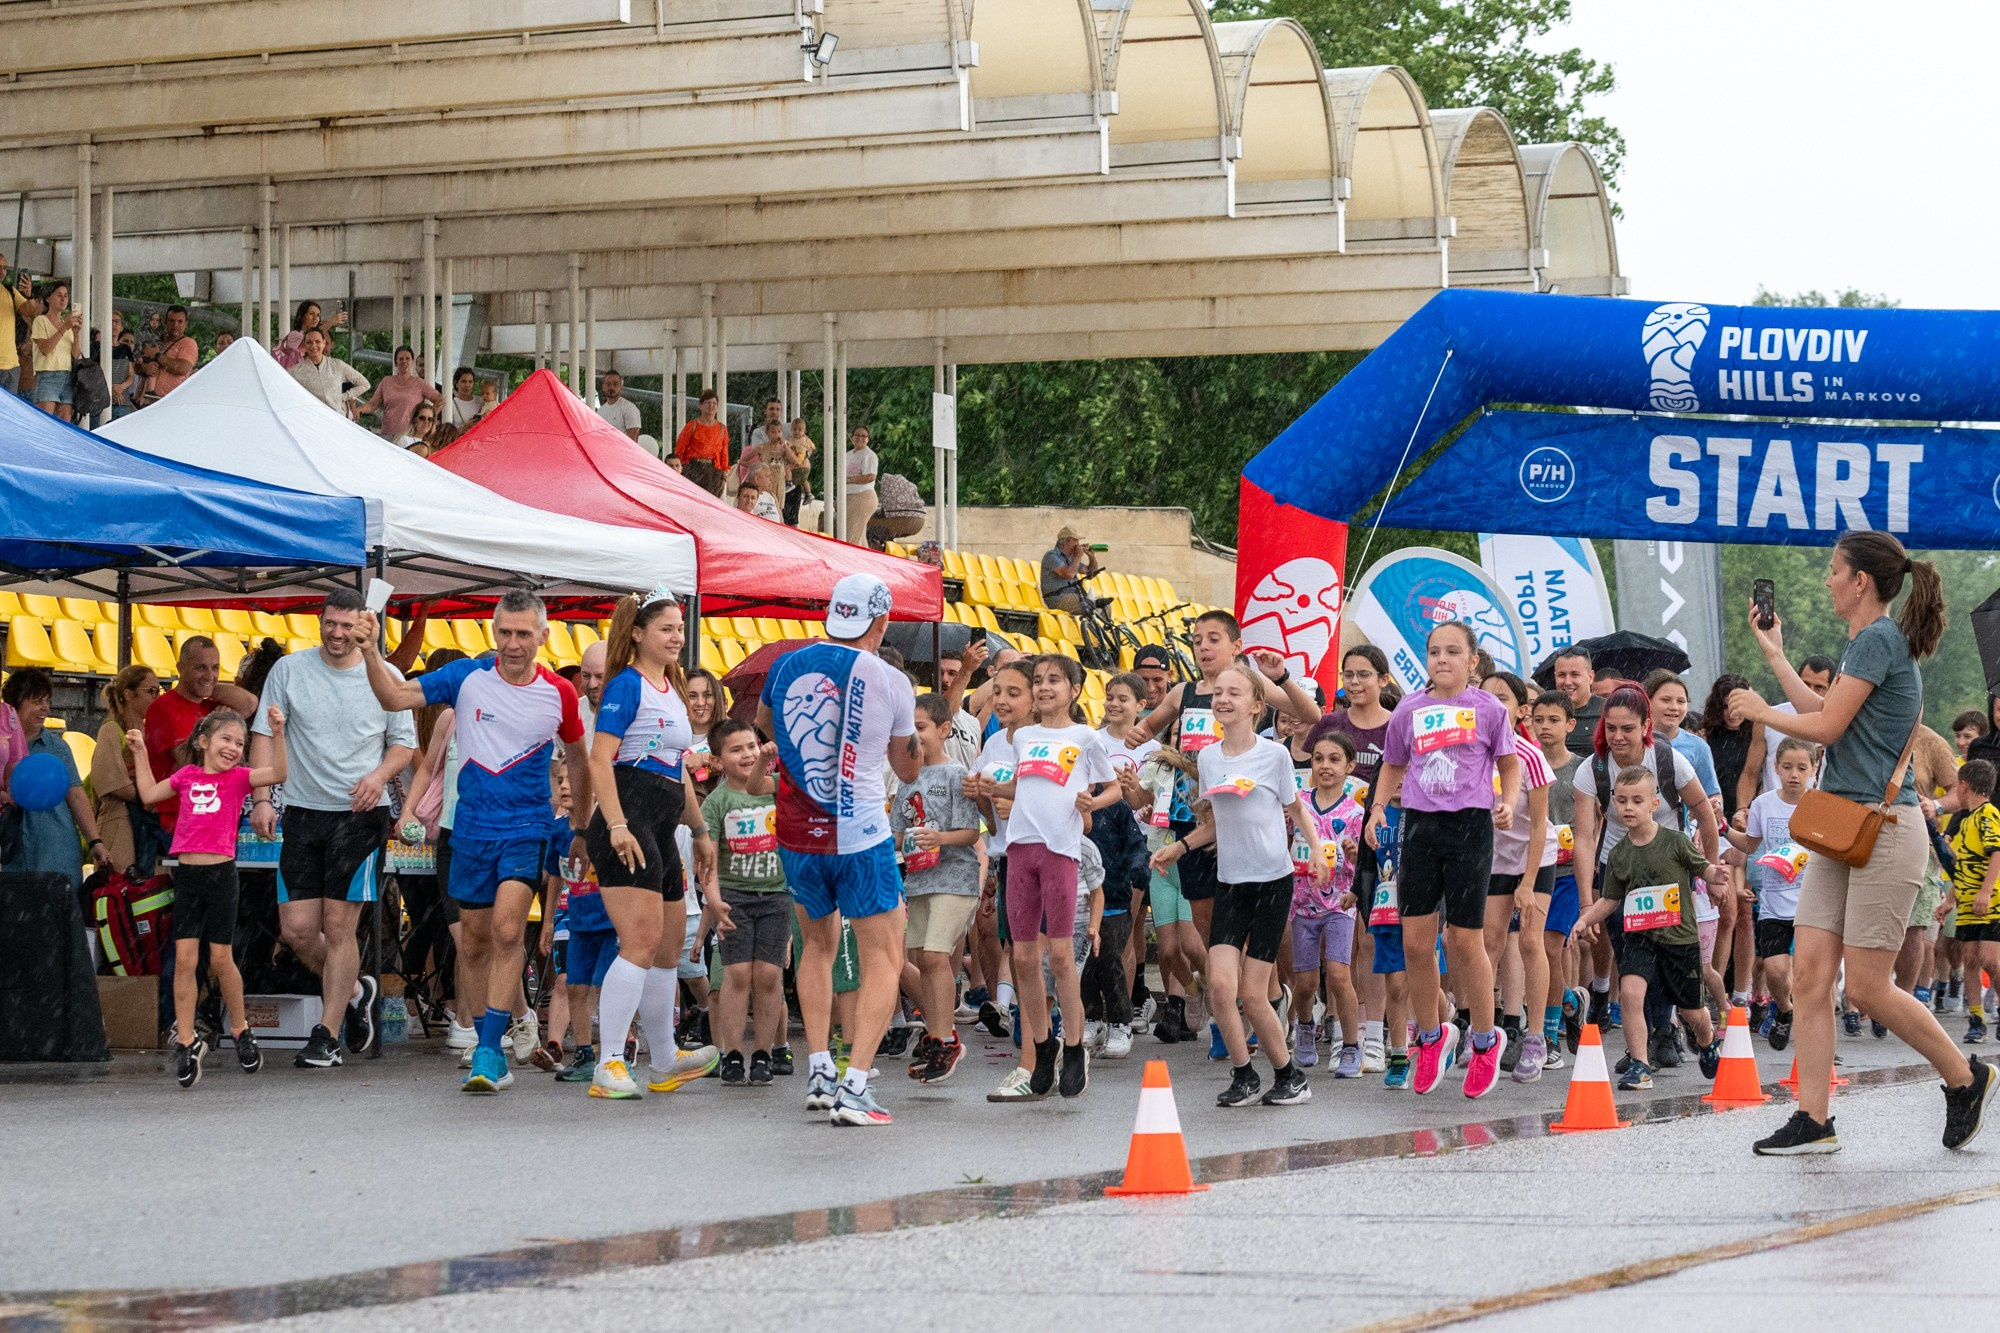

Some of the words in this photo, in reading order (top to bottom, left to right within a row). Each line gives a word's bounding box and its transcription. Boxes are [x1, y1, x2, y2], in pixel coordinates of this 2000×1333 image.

[1719, 326, 1868, 363] PLOVDIV
[1718, 369, 1814, 403] HILLS
[1824, 376, 1843, 387] IN
[1825, 391, 1921, 402] MARKOVO
[1530, 463, 1566, 482] P/H
[1646, 435, 1924, 533] START
[845, 676, 866, 745] MATTERS
[1185, 717, 1206, 731] 64
[1423, 713, 1446, 730] 97
[1028, 745, 1050, 758] 46
[841, 742, 857, 781] STEP
[840, 778, 854, 818] EVERY
[736, 819, 756, 835] 27
[1296, 845, 1309, 860] 11
[729, 851, 778, 878] EVER
[1635, 895, 1654, 911] 10
[841, 915, 853, 980] Champion
